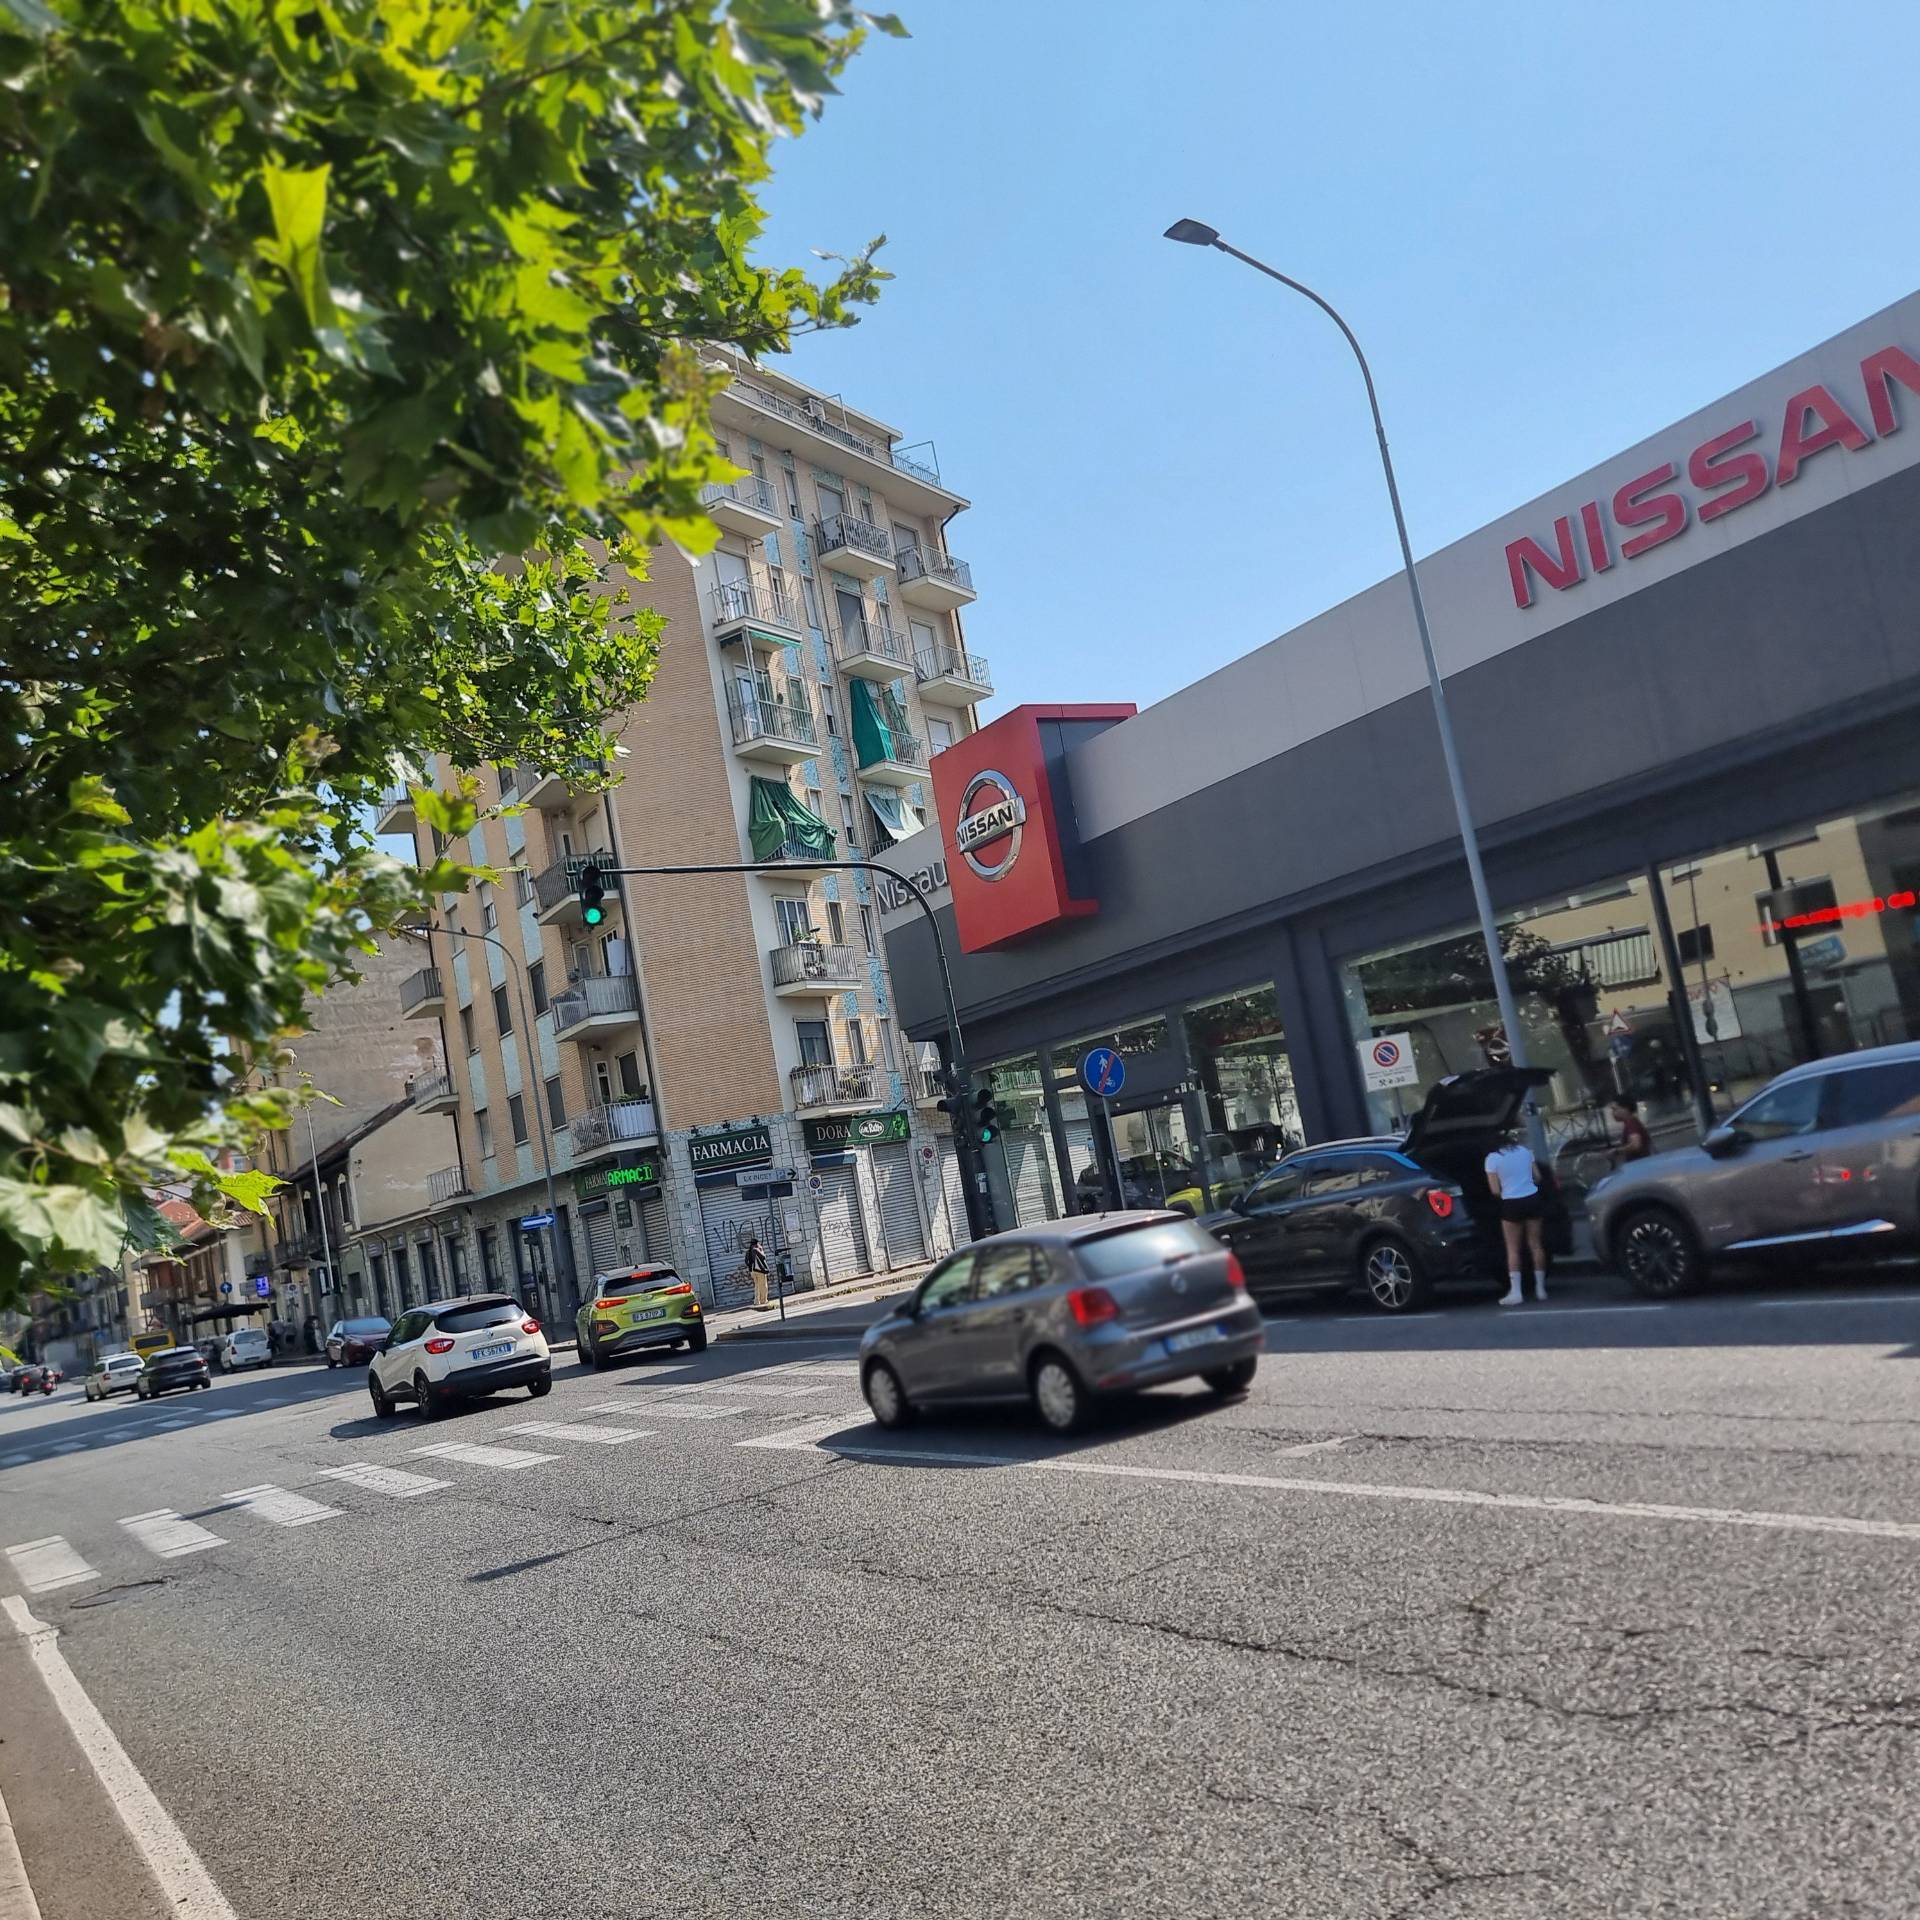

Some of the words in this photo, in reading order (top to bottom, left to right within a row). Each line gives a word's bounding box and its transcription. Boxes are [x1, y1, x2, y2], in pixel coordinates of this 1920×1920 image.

[957, 805, 1013, 845] NISSAN
[816, 1124, 851, 1140] DORA
[692, 1135, 770, 1161] FARMACIA
